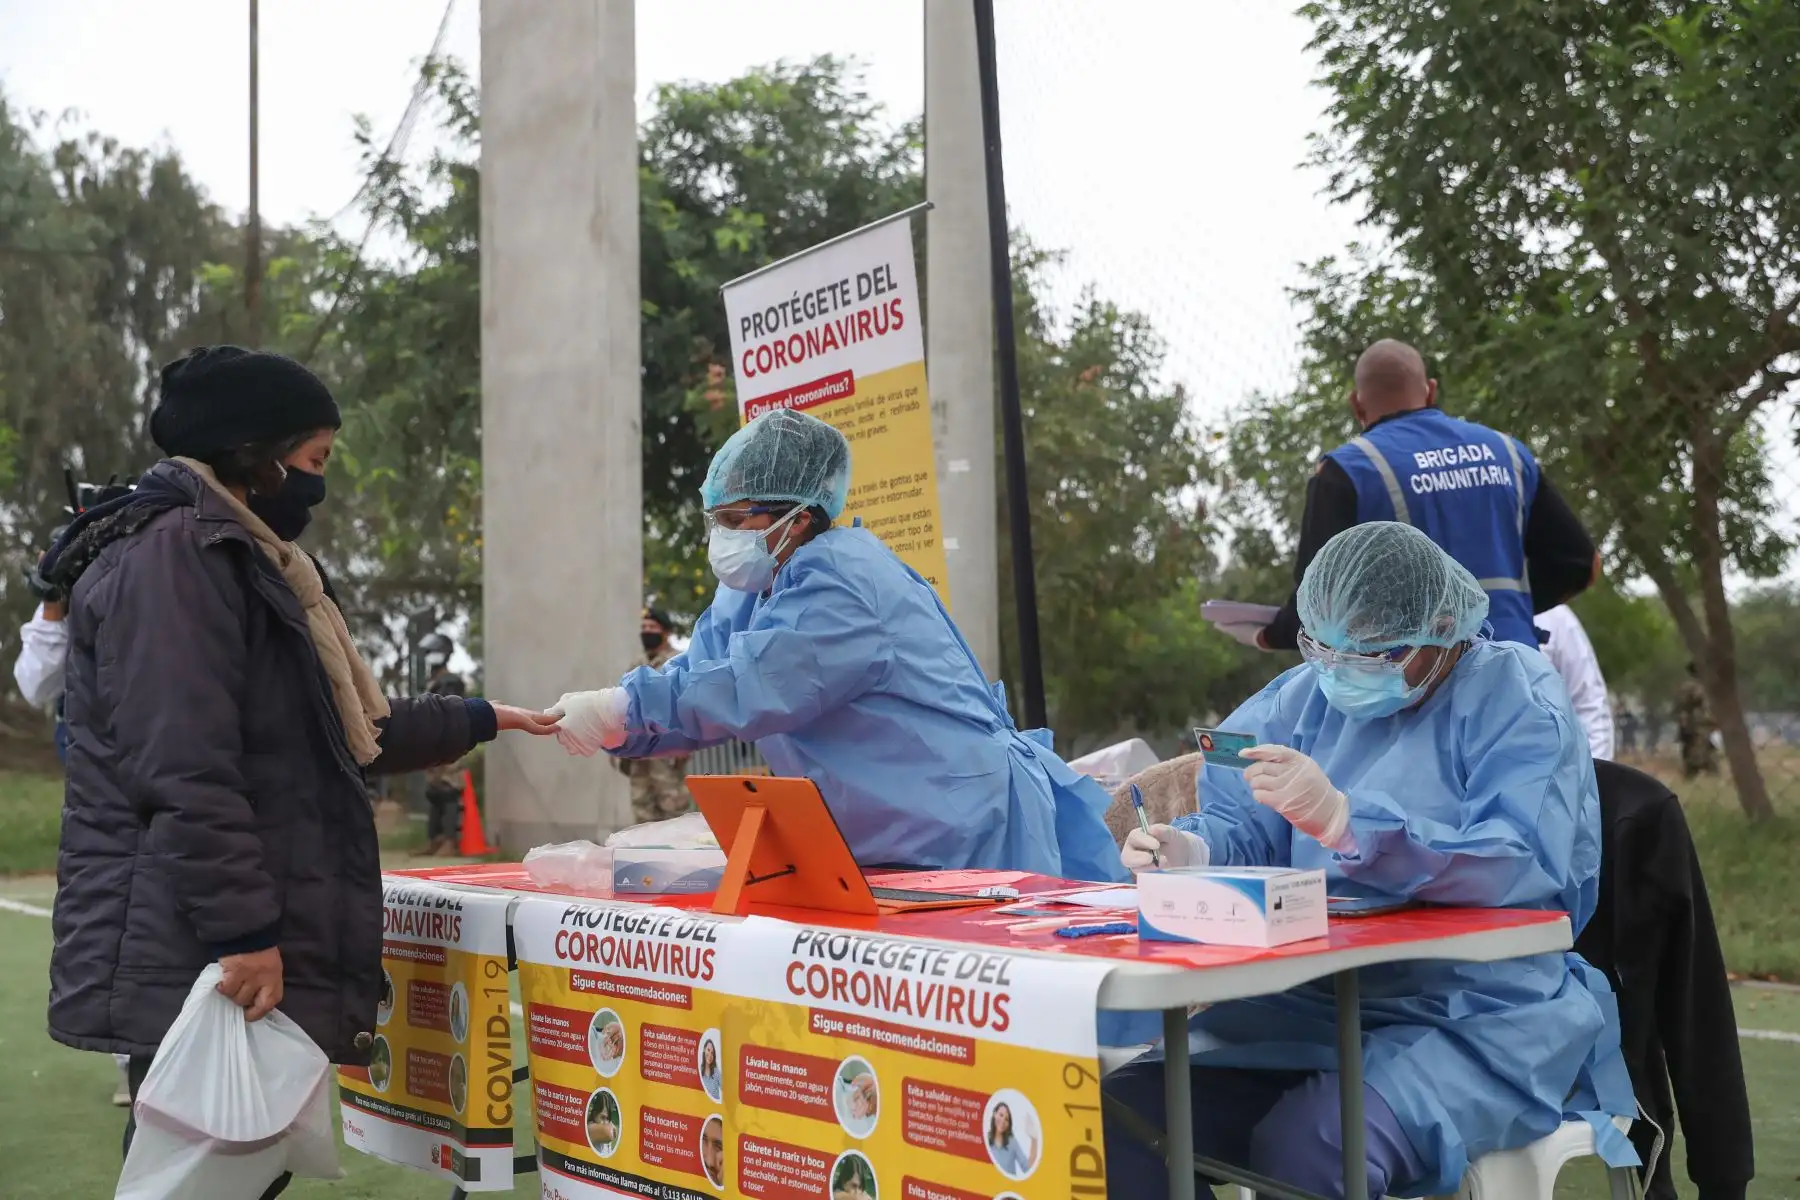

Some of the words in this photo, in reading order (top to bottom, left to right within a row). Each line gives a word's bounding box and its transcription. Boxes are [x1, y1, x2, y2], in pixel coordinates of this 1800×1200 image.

[741, 279, 851, 342] PROTÉGETE
[857, 263, 897, 301] DEL
[742, 298, 904, 377] CORONAVIRUS
[784, 393, 793, 408] el
[794, 377, 850, 405] coronavirus?
[1413, 443, 1496, 469] BRIGADA
[914, 472, 928, 482] que
[1410, 465, 1512, 494] COMUNITARIA
[924, 523, 933, 532] de
[924, 539, 934, 548] ver
[383, 906, 462, 943] ONAVIRUS
[676, 916, 722, 943] DEL
[390, 947, 445, 961] recomendaciones:
[555, 929, 716, 981] CORONAVIRUS
[954, 952, 1013, 986] DEL
[572, 974, 595, 991] Sigue
[598, 980, 615, 992] estas
[617, 984, 687, 1004] recomendaciones:
[786, 960, 1011, 1032] CORONAVIRUS
[552, 1018, 569, 1027] manos
[484, 960, 513, 1125] COVID-19
[570, 1033, 581, 1041] agua
[656, 1032, 676, 1042] saludar
[812, 1013, 844, 1033] Sigue
[846, 1022, 871, 1038] estas
[872, 1028, 968, 1058] recomendaciones:
[746, 1056, 769, 1069] Lávate
[770, 1060, 780, 1071] las
[782, 1065, 807, 1076] manos
[745, 1068, 794, 1087] frecuentemente,
[796, 1081, 807, 1089] con
[808, 1082, 823, 1093] agua
[824, 1086, 829, 1095] y
[745, 1081, 763, 1094] jabón,
[765, 1085, 788, 1097] mínimo
[789, 1090, 796, 1099] 20
[798, 1093, 828, 1106] segundos.
[908, 1084, 924, 1096] Evita
[925, 1089, 951, 1103] saludar
[570, 1094, 582, 1104] boca
[644, 1112, 656, 1124] Evita
[657, 1116, 678, 1128] tocarte
[680, 1121, 688, 1131] los
[935, 1127, 947, 1136] con
[1063, 1062, 1106, 1200] ID-19
[644, 1138, 655, 1150] boca,
[675, 1148, 694, 1157] manos
[654, 1128, 659, 1138] la
[660, 1131, 673, 1141] nariz
[678, 1134, 684, 1143] la
[744, 1141, 772, 1156] Cúbrete
[774, 1147, 780, 1157] la
[782, 1152, 800, 1163] nariz
[801, 1156, 806, 1166] y
[807, 1155, 825, 1168] boca
[564, 1161, 575, 1172] Para
[576, 1165, 587, 1174] más
[588, 1168, 619, 1184] información
[621, 1177, 637, 1189] llama
[638, 1183, 653, 1195] gratis
[653, 1187, 660, 1196] al
[668, 1190, 680, 1200] 113
[743, 1167, 780, 1184] desechable,
[781, 1176, 787, 1184] al
[744, 1156, 754, 1164] con
[755, 1158, 761, 1166] el
[763, 1160, 794, 1174] antebrazo
[801, 1169, 826, 1182] pañuelo
[748, 1181, 764, 1192] toser.
[908, 1184, 925, 1198] Evita
